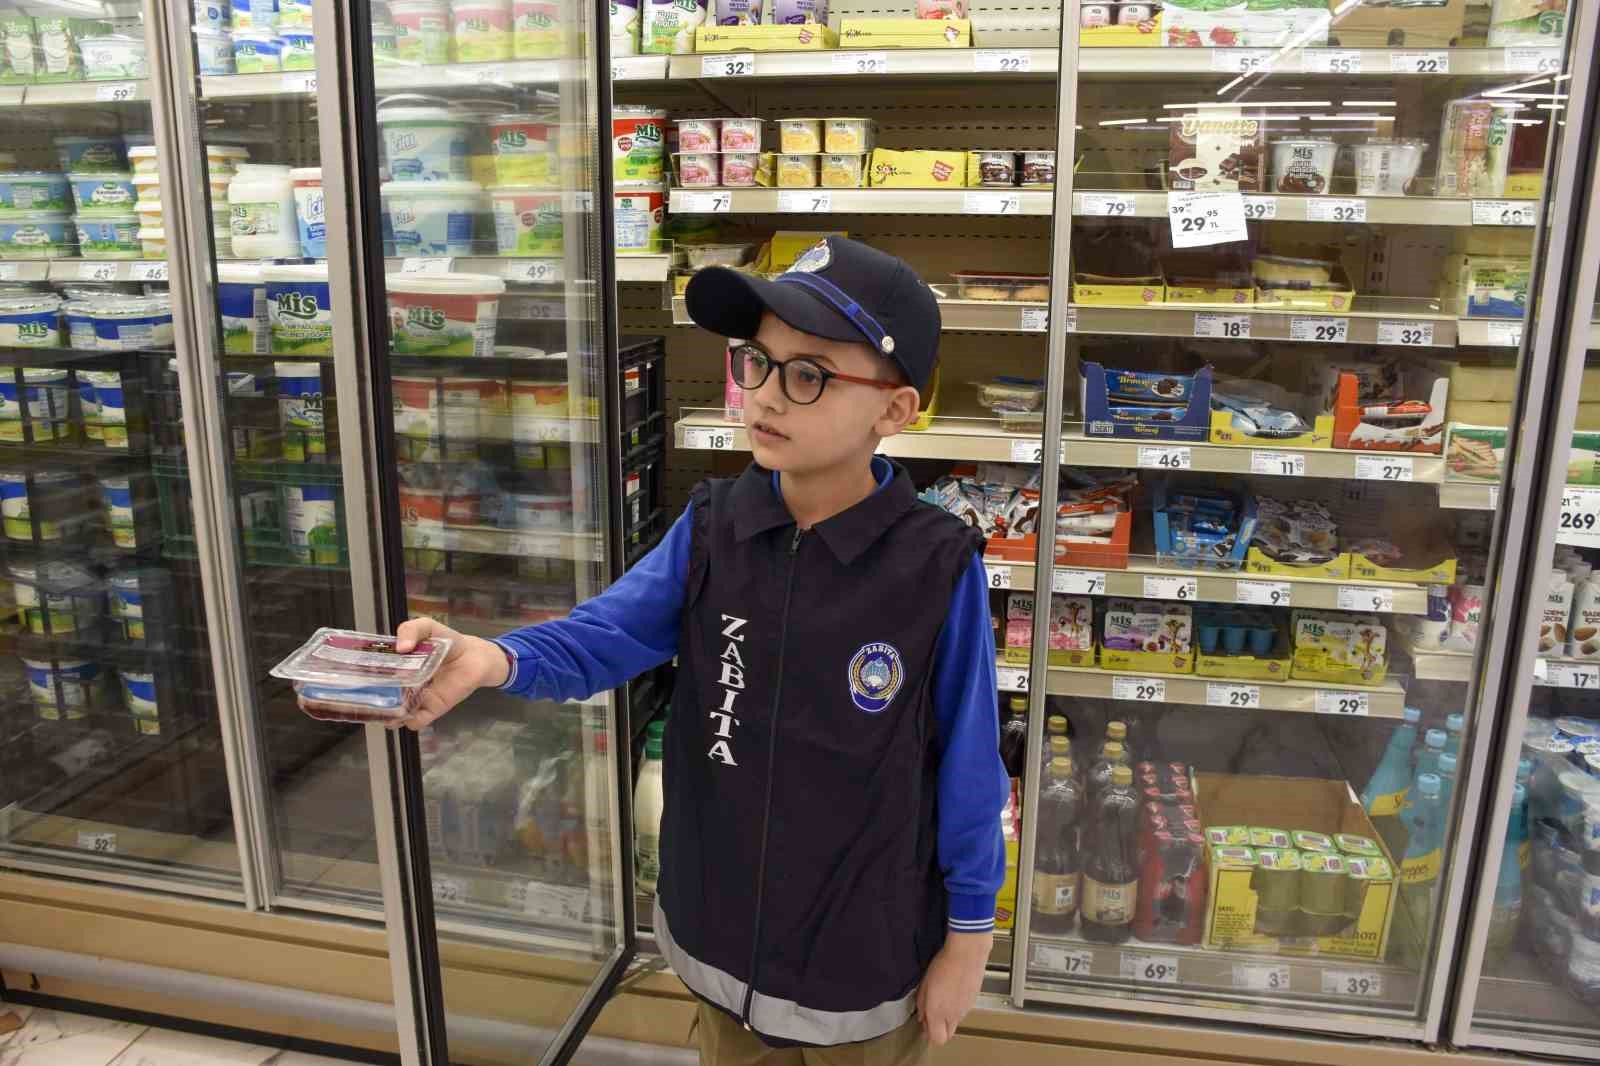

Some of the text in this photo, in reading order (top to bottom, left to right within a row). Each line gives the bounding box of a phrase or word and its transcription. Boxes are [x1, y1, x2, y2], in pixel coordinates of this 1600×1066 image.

[726, 62, 744, 75] 32
[857, 59, 876, 73] 32
[1000, 58, 1019, 71] 22
[1330, 59, 1349, 72] 55
[1417, 60, 1437, 72] 22
[113, 89, 128, 101] 59
[713, 198, 722, 211] 7
[812, 198, 821, 211] 7
[1000, 200, 1009, 213] 7
[1106, 202, 1126, 214] 79
[1244, 204, 1266, 218] 39
[1334, 207, 1354, 221] 32
[1181, 217, 1206, 232] 29
[94, 269, 109, 279] 43
[146, 269, 162, 279] 46
[527, 265, 546, 279] 49
[278, 293, 317, 314] Mis
[1223, 322, 1240, 336] 18
[1315, 326, 1336, 340] 29
[1401, 330, 1421, 344] 32
[708, 435, 724, 449] 18
[1159, 454, 1180, 467] 46
[1281, 461, 1293, 474] 11
[1383, 466, 1401, 479] 27
[1560, 513, 1595, 529] 269
[991, 574, 1001, 587] 8
[1088, 580, 1097, 593] 7
[1177, 585, 1187, 599] 6
[1270, 590, 1280, 604] 9
[1372, 596, 1382, 609] 9
[1573, 673, 1588, 687] 17
[1136, 685, 1156, 699] 29
[1230, 692, 1250, 706] 29
[1339, 699, 1359, 713] 29
[94, 838, 109, 850] 52
[1064, 956, 1081, 971] 17
[1144, 964, 1166, 979] 69
[1269, 972, 1279, 987] 3
[1347, 978, 1370, 994] 39
